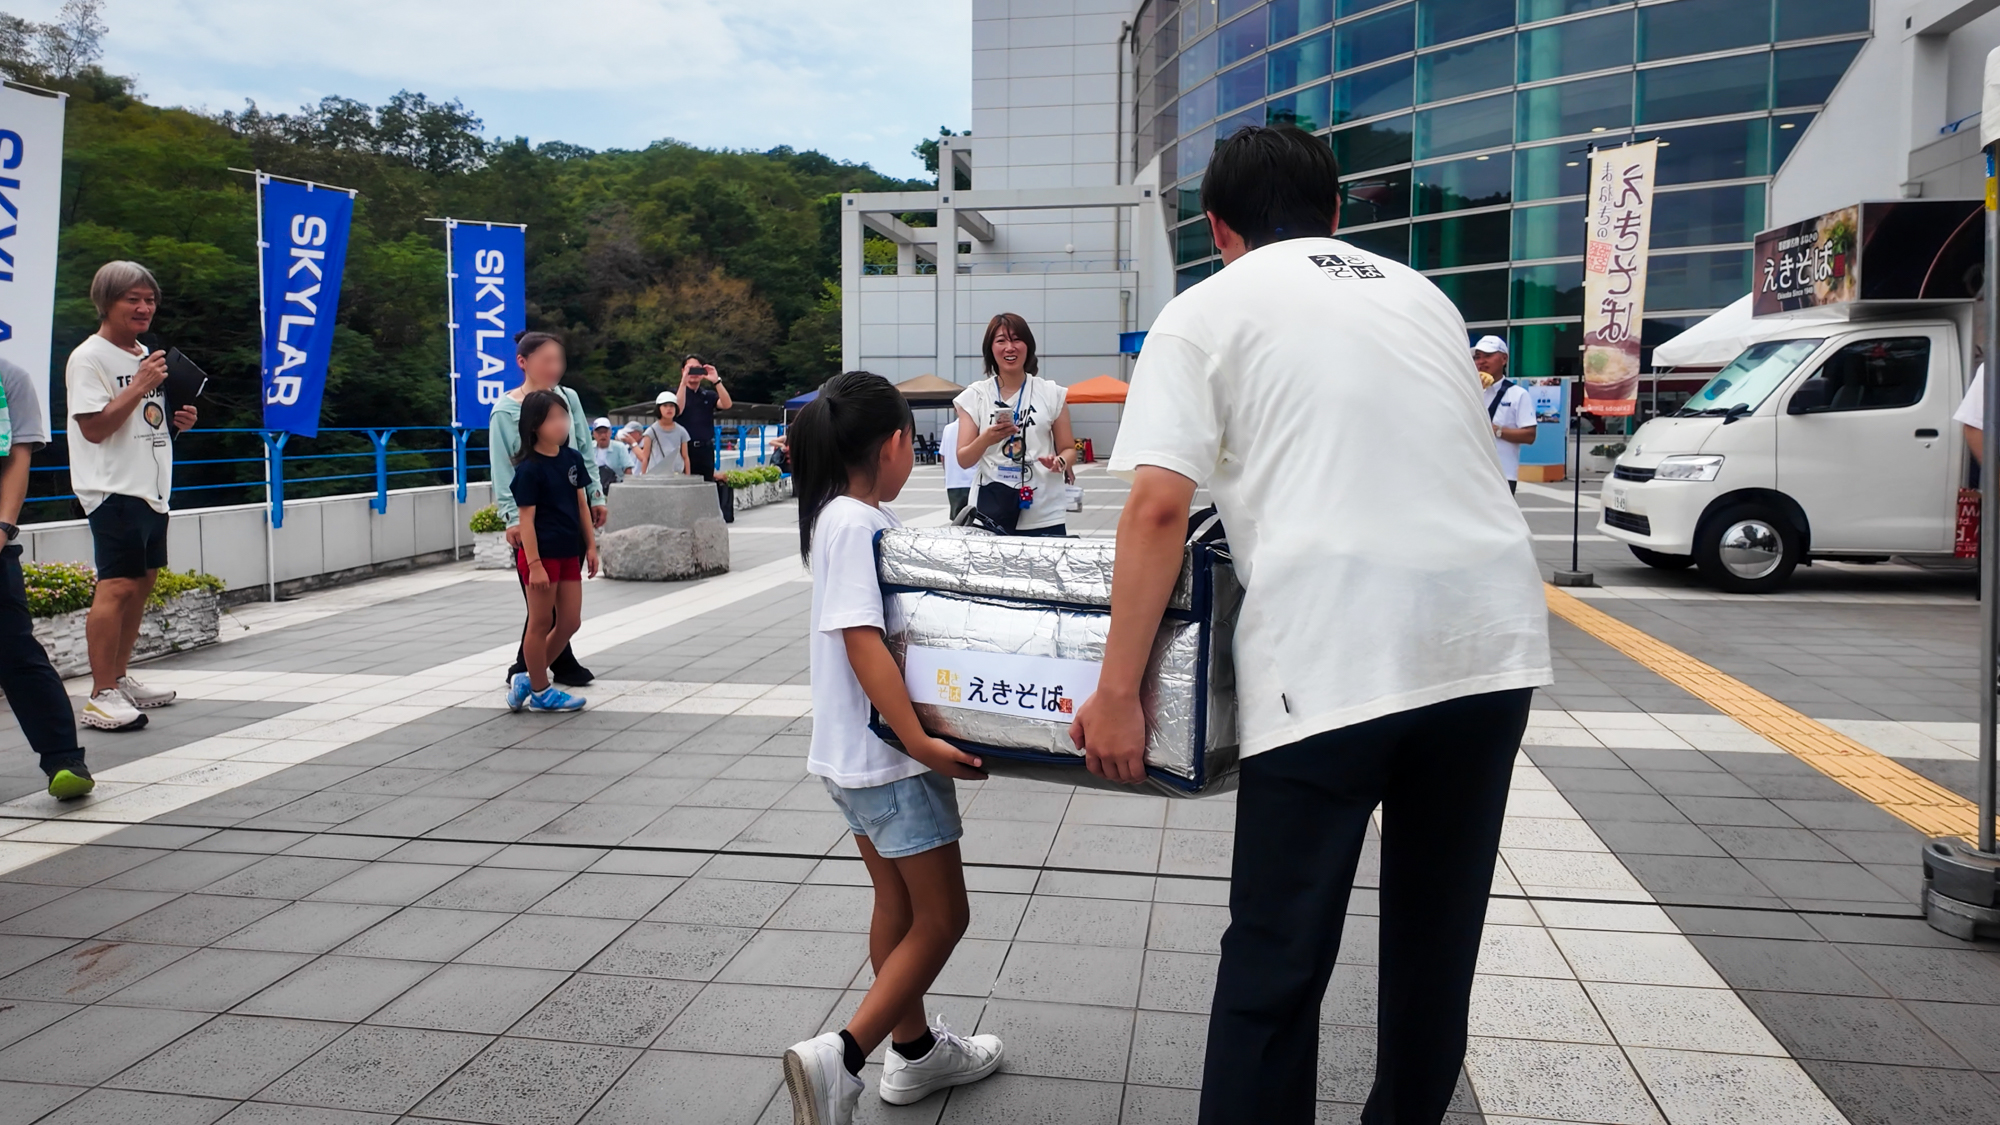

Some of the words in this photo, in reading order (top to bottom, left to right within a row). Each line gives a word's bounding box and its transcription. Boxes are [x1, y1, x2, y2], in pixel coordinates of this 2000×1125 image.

[266, 213, 327, 406] SKYLAB
[1762, 240, 1833, 293] えきそば
[475, 249, 505, 405] SKYLAB
[967, 676, 1064, 712] えきそば
